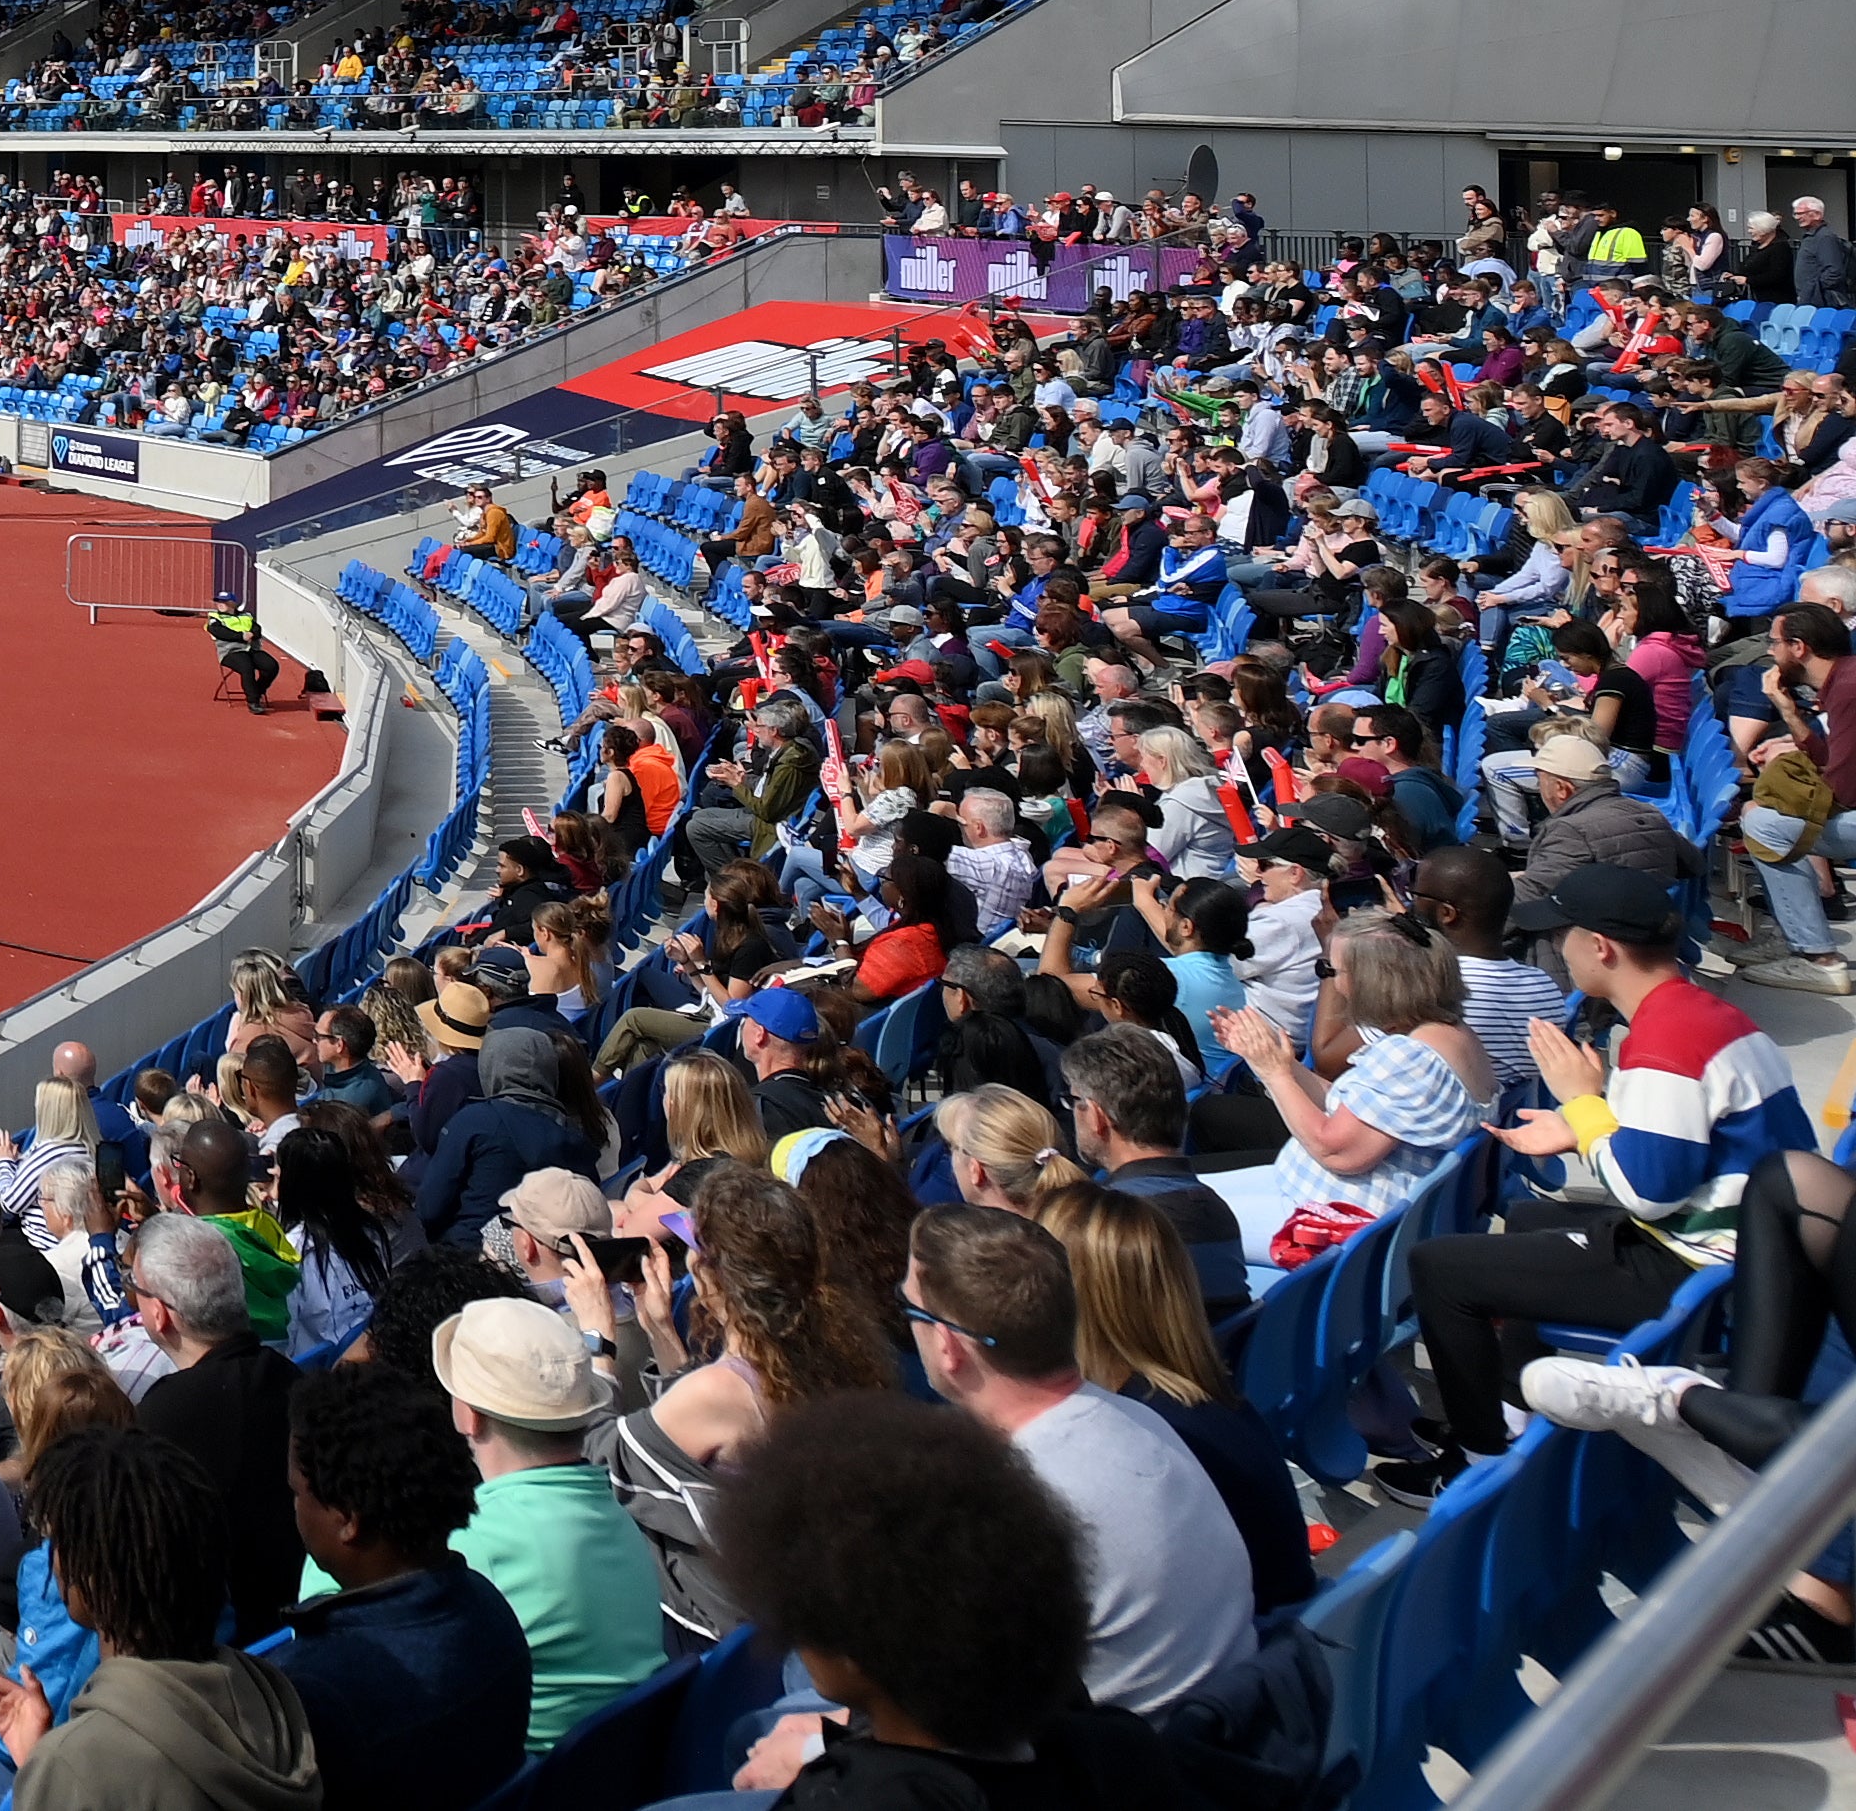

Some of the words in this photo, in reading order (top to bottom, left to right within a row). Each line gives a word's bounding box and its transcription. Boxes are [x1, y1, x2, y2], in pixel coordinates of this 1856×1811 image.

[899, 245, 958, 293] müller
[986, 250, 1050, 301] müller
[68, 451, 104, 470] DIAMOND
[104, 457, 135, 475] LEAGUE
